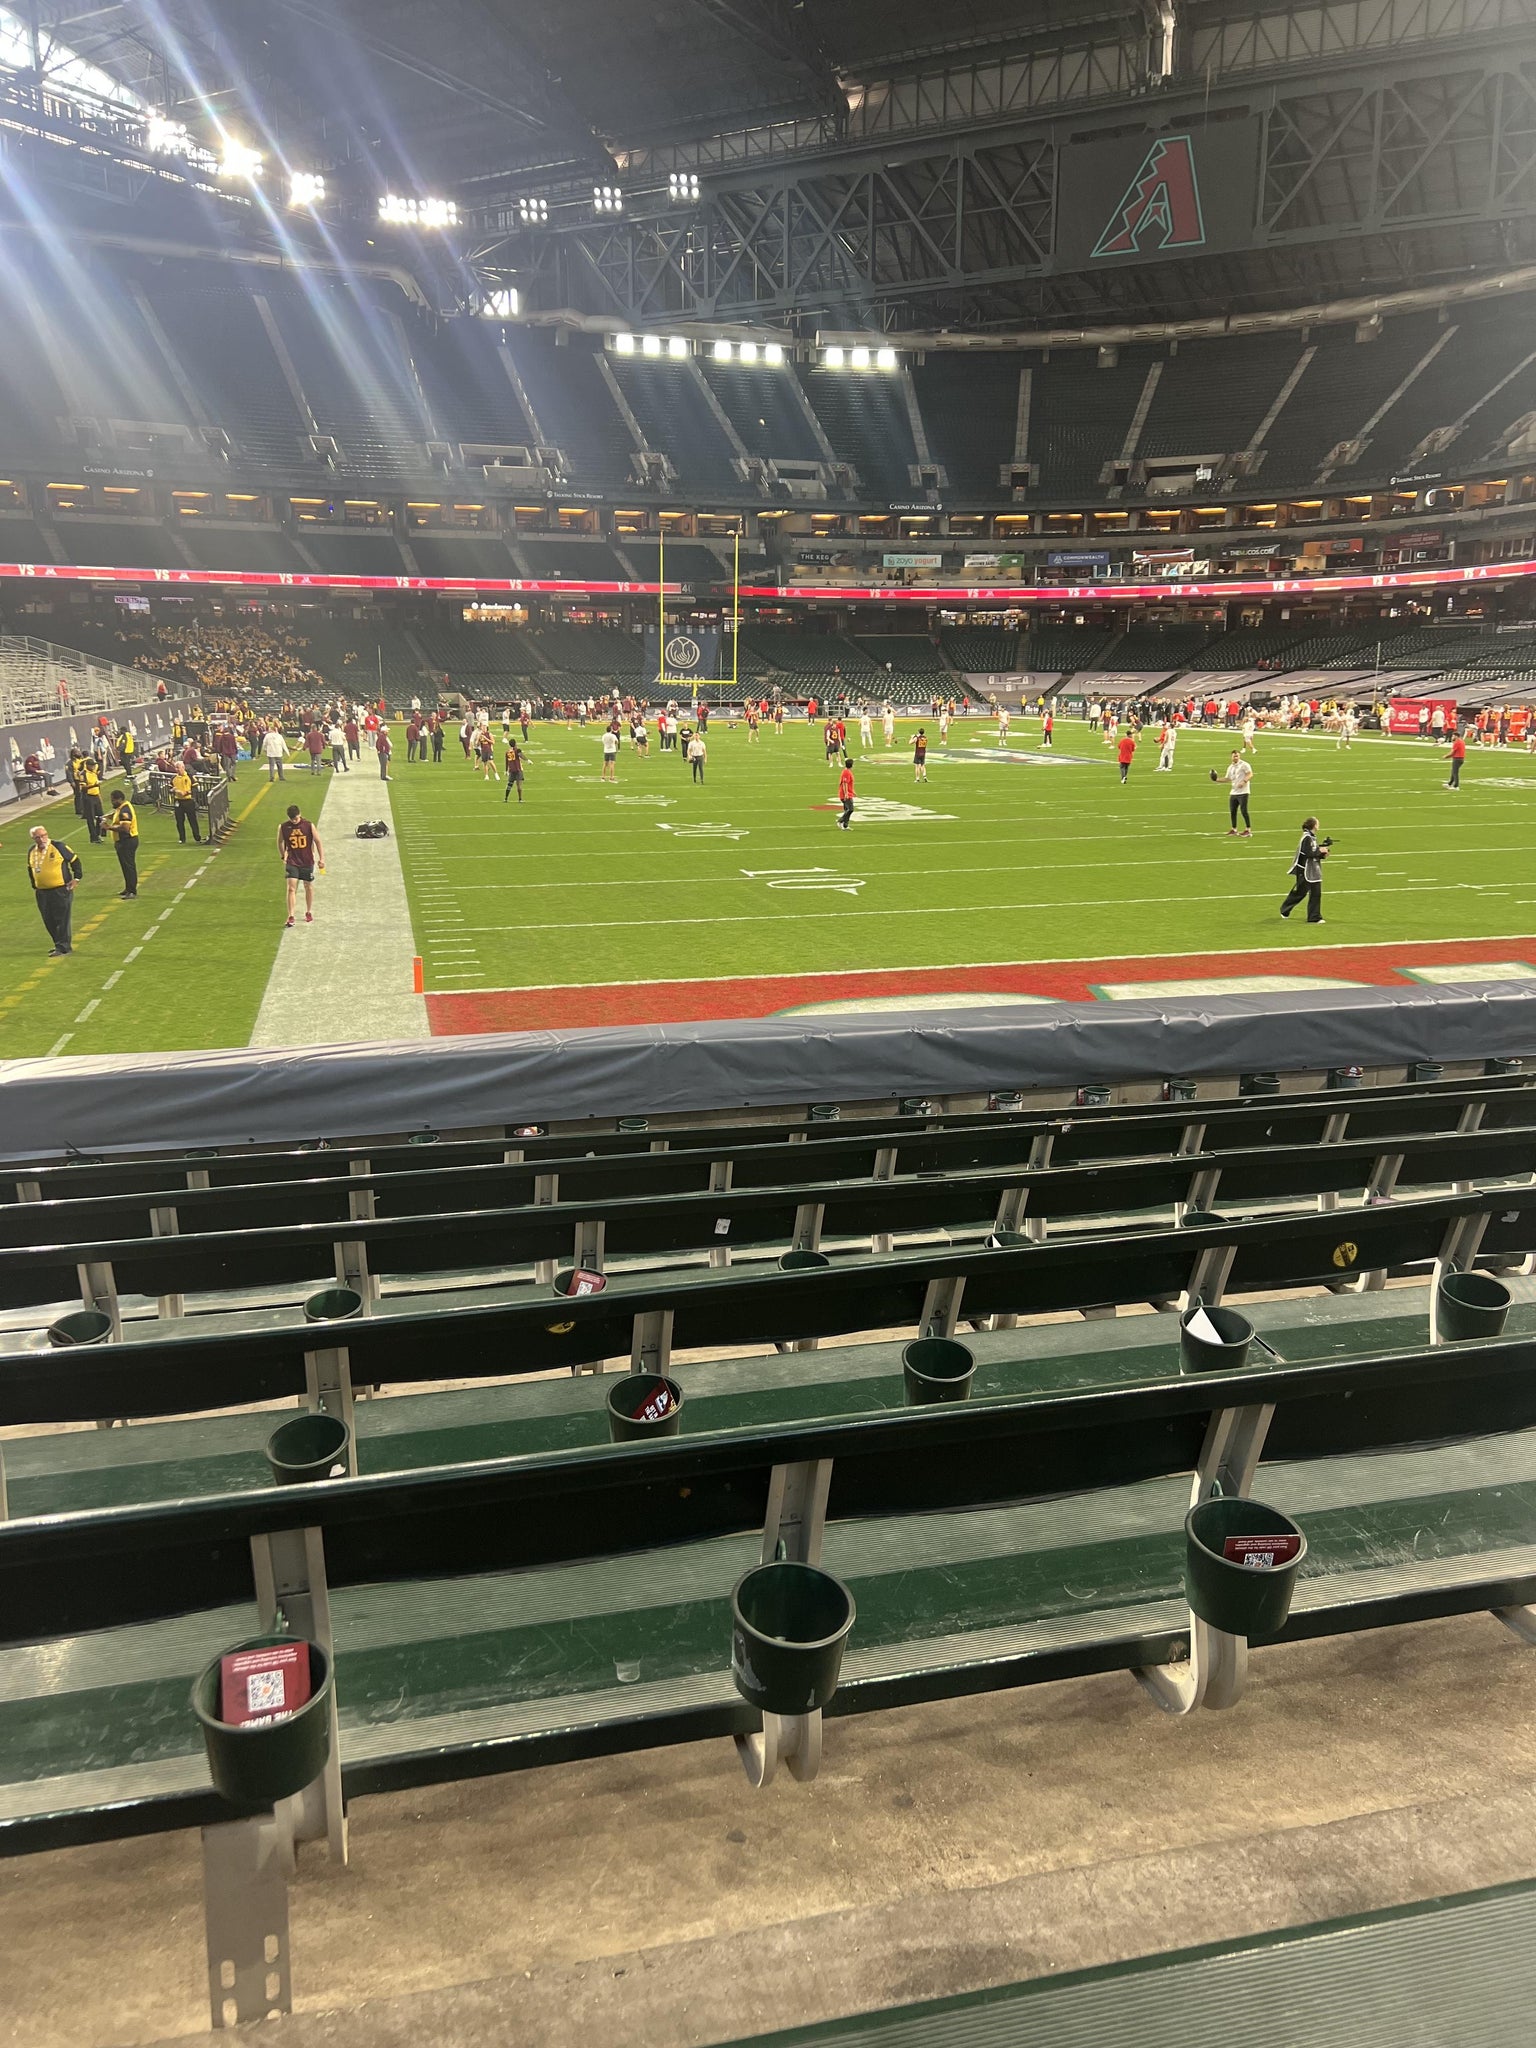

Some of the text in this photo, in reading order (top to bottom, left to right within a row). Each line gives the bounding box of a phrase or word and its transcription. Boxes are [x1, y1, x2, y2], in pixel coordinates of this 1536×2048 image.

[801, 553, 813, 561] THE
[896, 557, 937, 566] zoyo yogurt
[18, 564, 35, 576] VS
[153, 569, 170, 581] VS
[279, 573, 294, 584] VS
[395, 576, 409, 588] VS
[509, 579, 522, 590] VS
[617, 581, 630, 592] VS
[1170, 585, 1183, 594] VS
[869, 589, 880, 598] VS
[967, 589, 980, 598] VS
[1068, 587, 1080, 597] VS
[652, 672, 706, 688] Allstate
[289, 835, 307, 849] 30
[739, 867, 867, 890] 10
